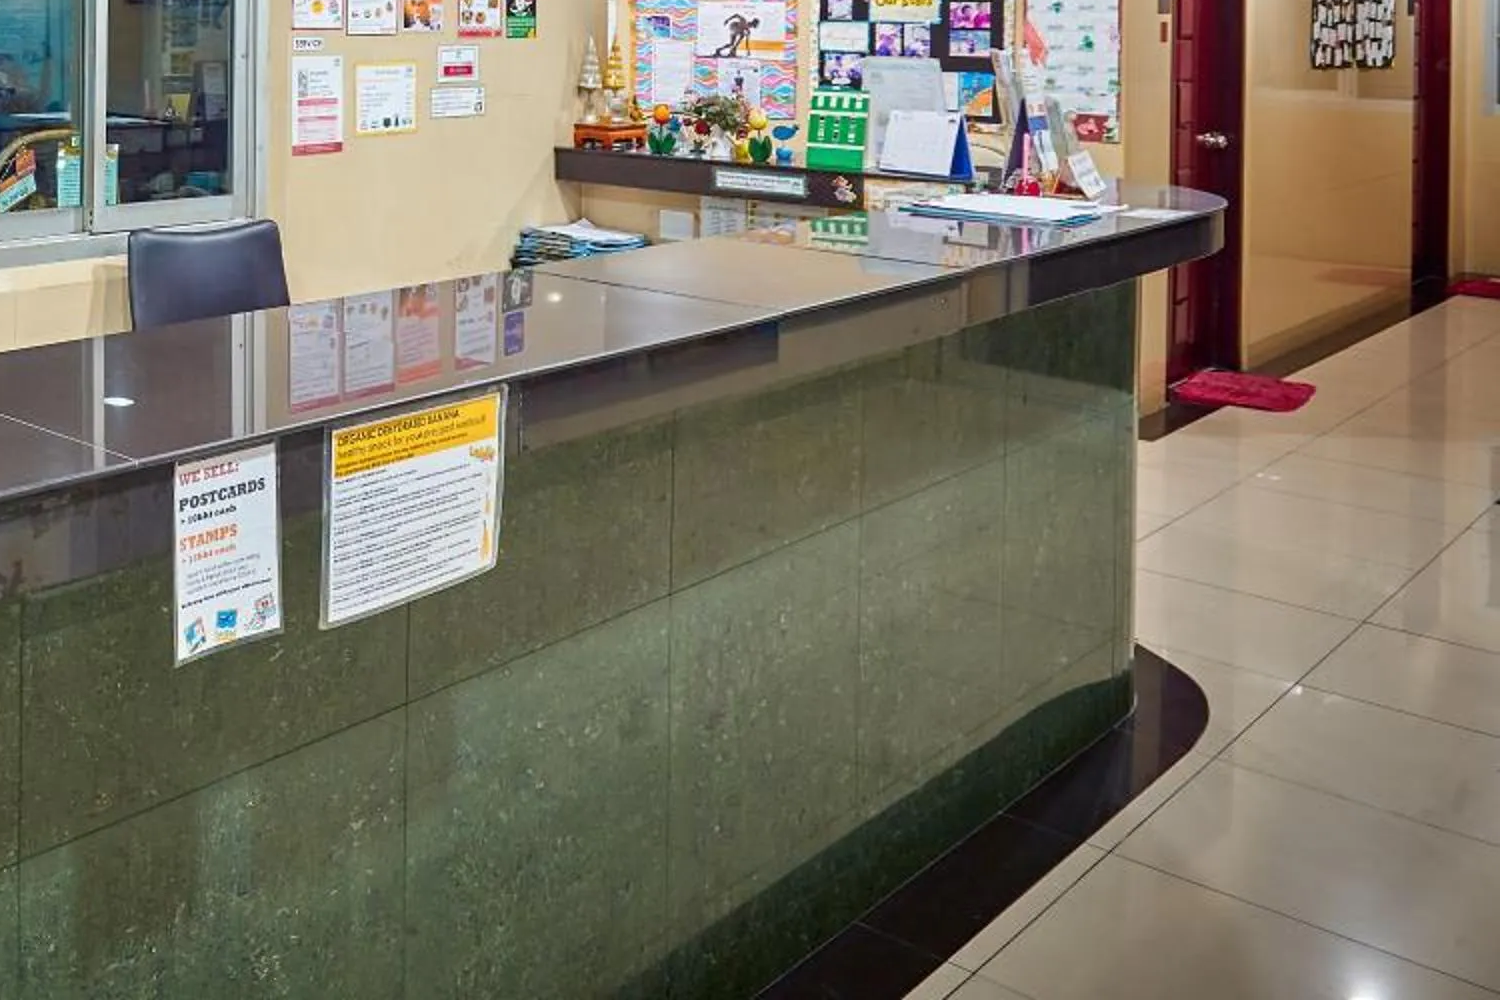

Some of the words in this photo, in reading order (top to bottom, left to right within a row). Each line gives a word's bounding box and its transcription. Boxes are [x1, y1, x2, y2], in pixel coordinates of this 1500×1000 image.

[179, 468, 200, 487] WE
[203, 461, 240, 481] SELL:
[178, 476, 266, 513] POSTCARDS
[179, 523, 238, 552] STAMPS
